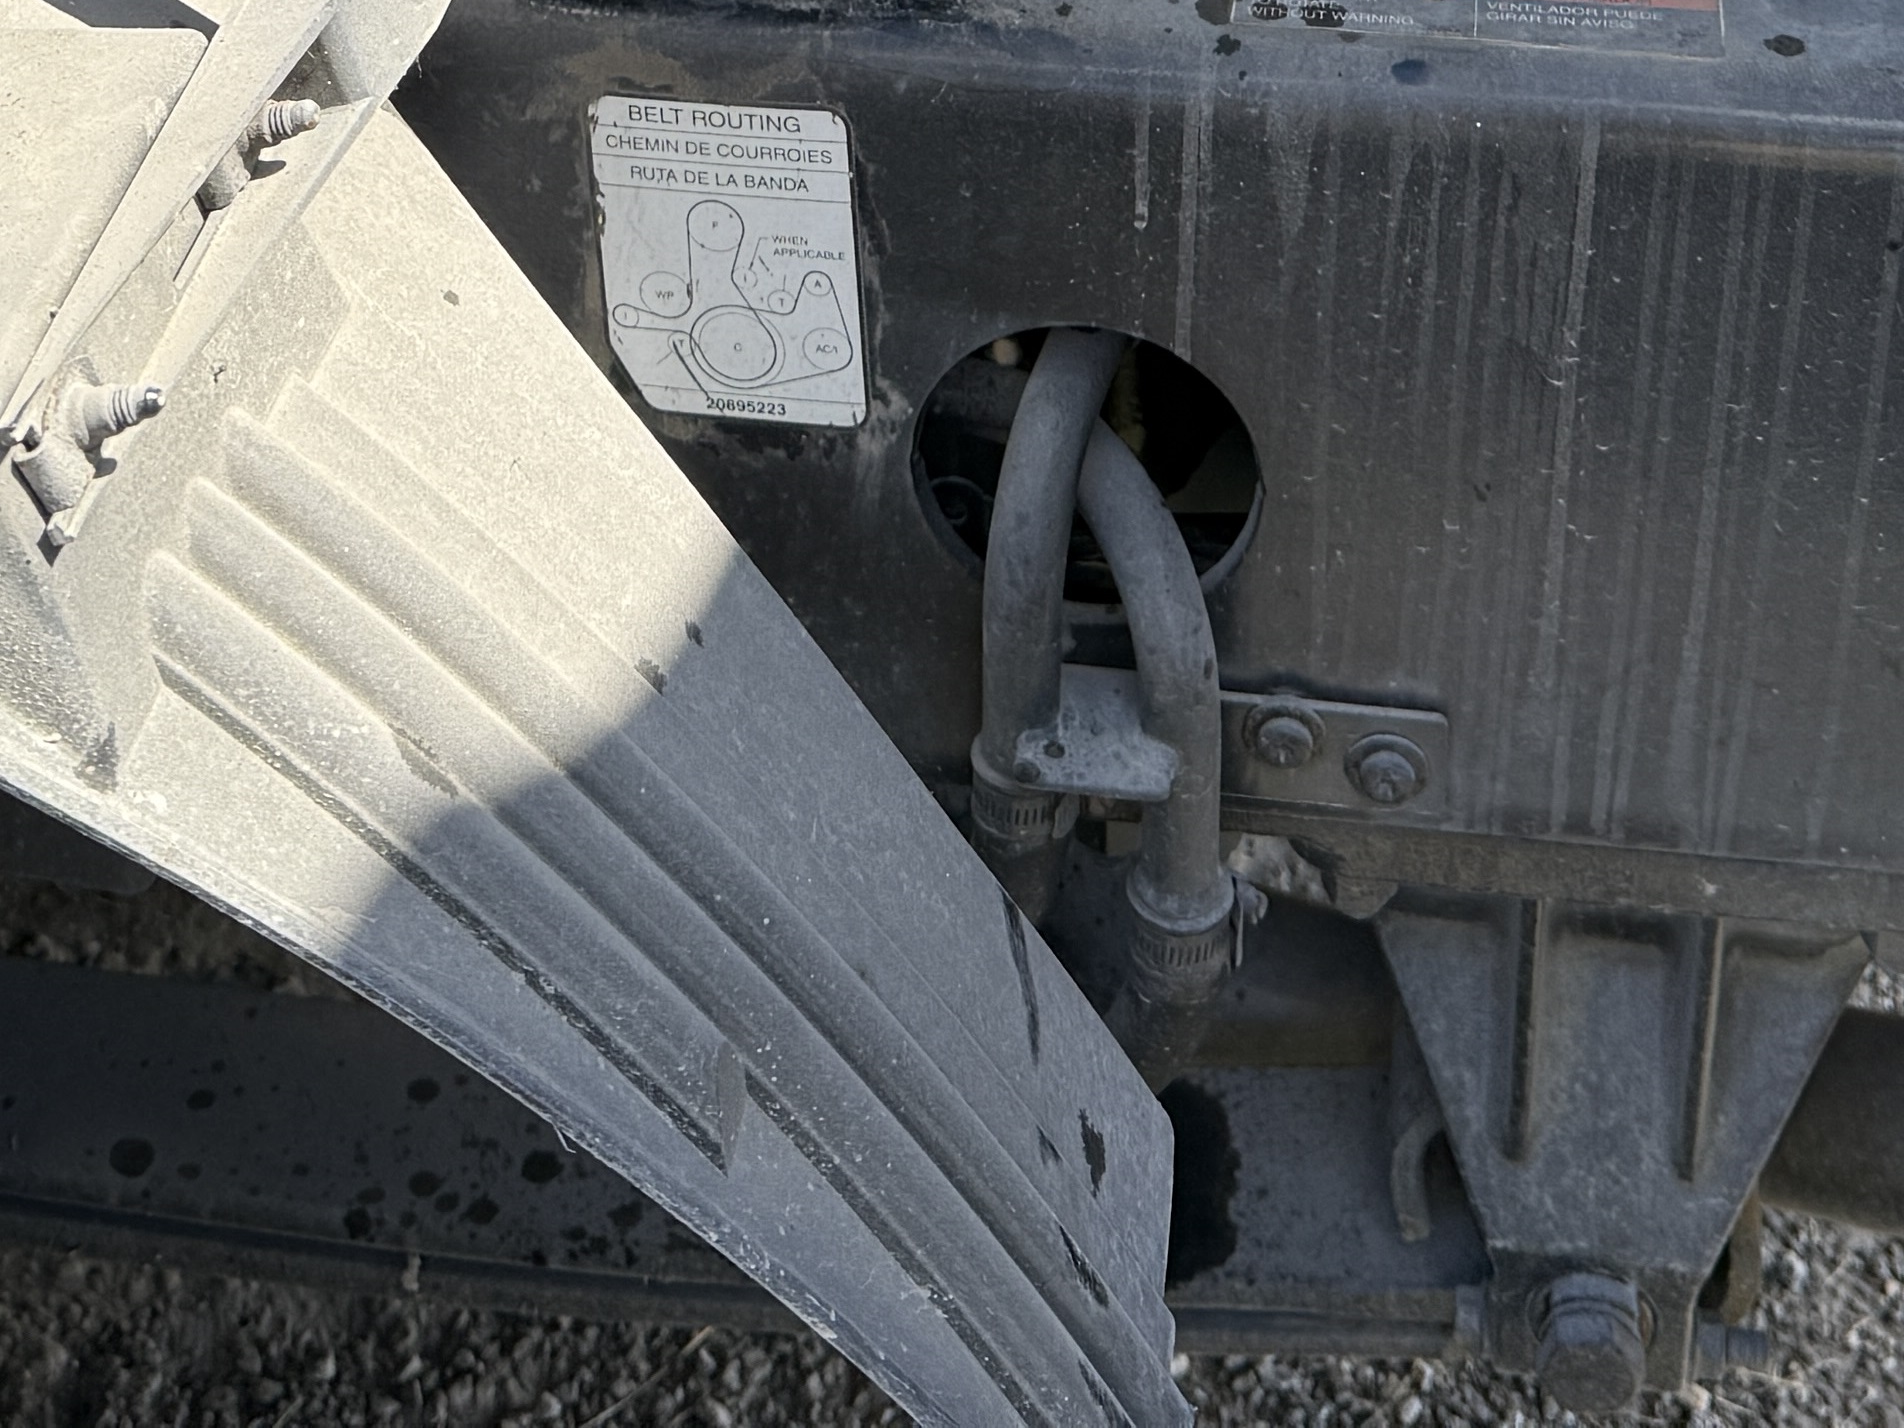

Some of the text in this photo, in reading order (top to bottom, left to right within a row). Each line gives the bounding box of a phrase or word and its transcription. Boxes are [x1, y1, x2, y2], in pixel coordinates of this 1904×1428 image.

[1247, 5, 1415, 25] WITHOUT WARNING
[1487, 1, 1663, 21] VENTILADOR PUEDE
[1487, 11, 1635, 29] GIRAR SIN AVISO
[628, 104, 801, 133] BELT ROUTING
[605, 134, 833, 164] CHEMIN DE COURROIES
[630, 165, 809, 192] RUTA DE LA BANDA
[772, 235, 809, 246] WHEN
[773, 248, 846, 261] APPLICABLE
[814, 279, 823, 288] A
[706, 397, 787, 417] 20895223
